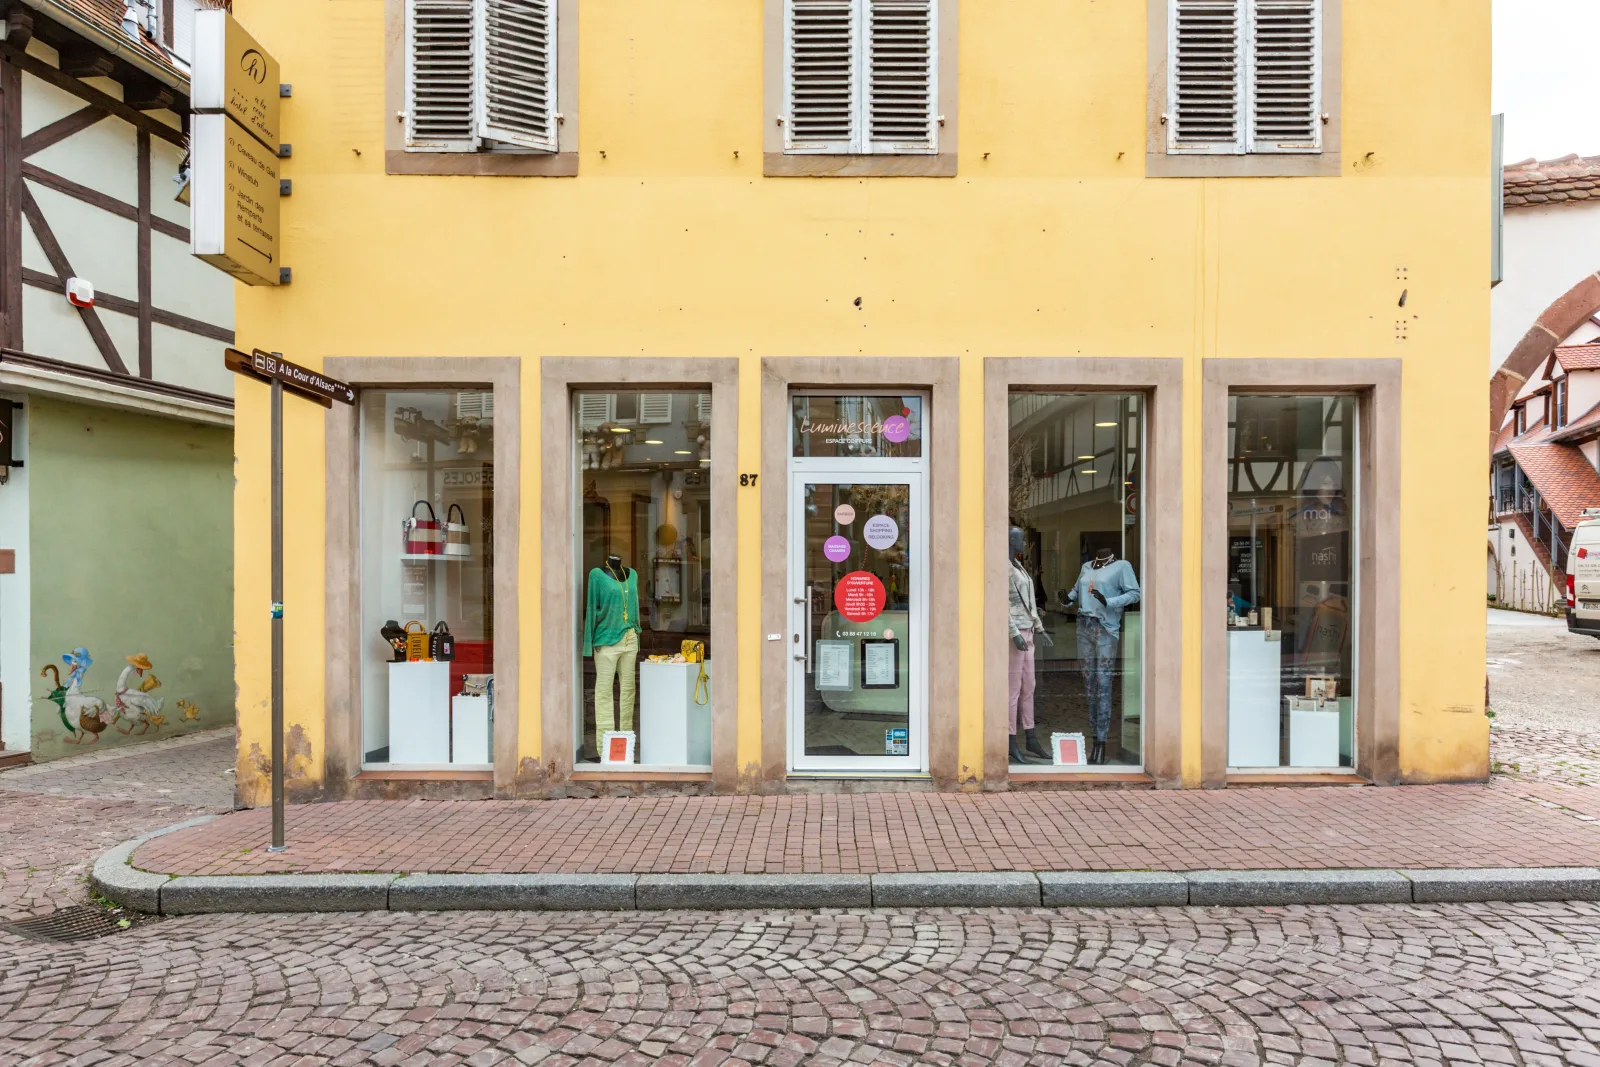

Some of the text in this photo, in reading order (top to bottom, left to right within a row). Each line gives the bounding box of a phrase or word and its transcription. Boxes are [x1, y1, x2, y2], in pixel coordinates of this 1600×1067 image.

[237, 143, 258, 165] Caveau
[258, 160, 265, 171] de
[237, 166, 259, 188] Winstub
[236, 190, 264, 214] Jardin des
[236, 200, 263, 224] Remparts
[236, 214, 273, 242] et sa terrasse
[278, 364, 284, 374] A
[286, 366, 292, 376] la
[293, 368, 309, 383] Cour
[800, 415, 905, 434] Luminescence
[740, 474, 758, 486] 87
[1312, 550, 1336, 561] nashi
